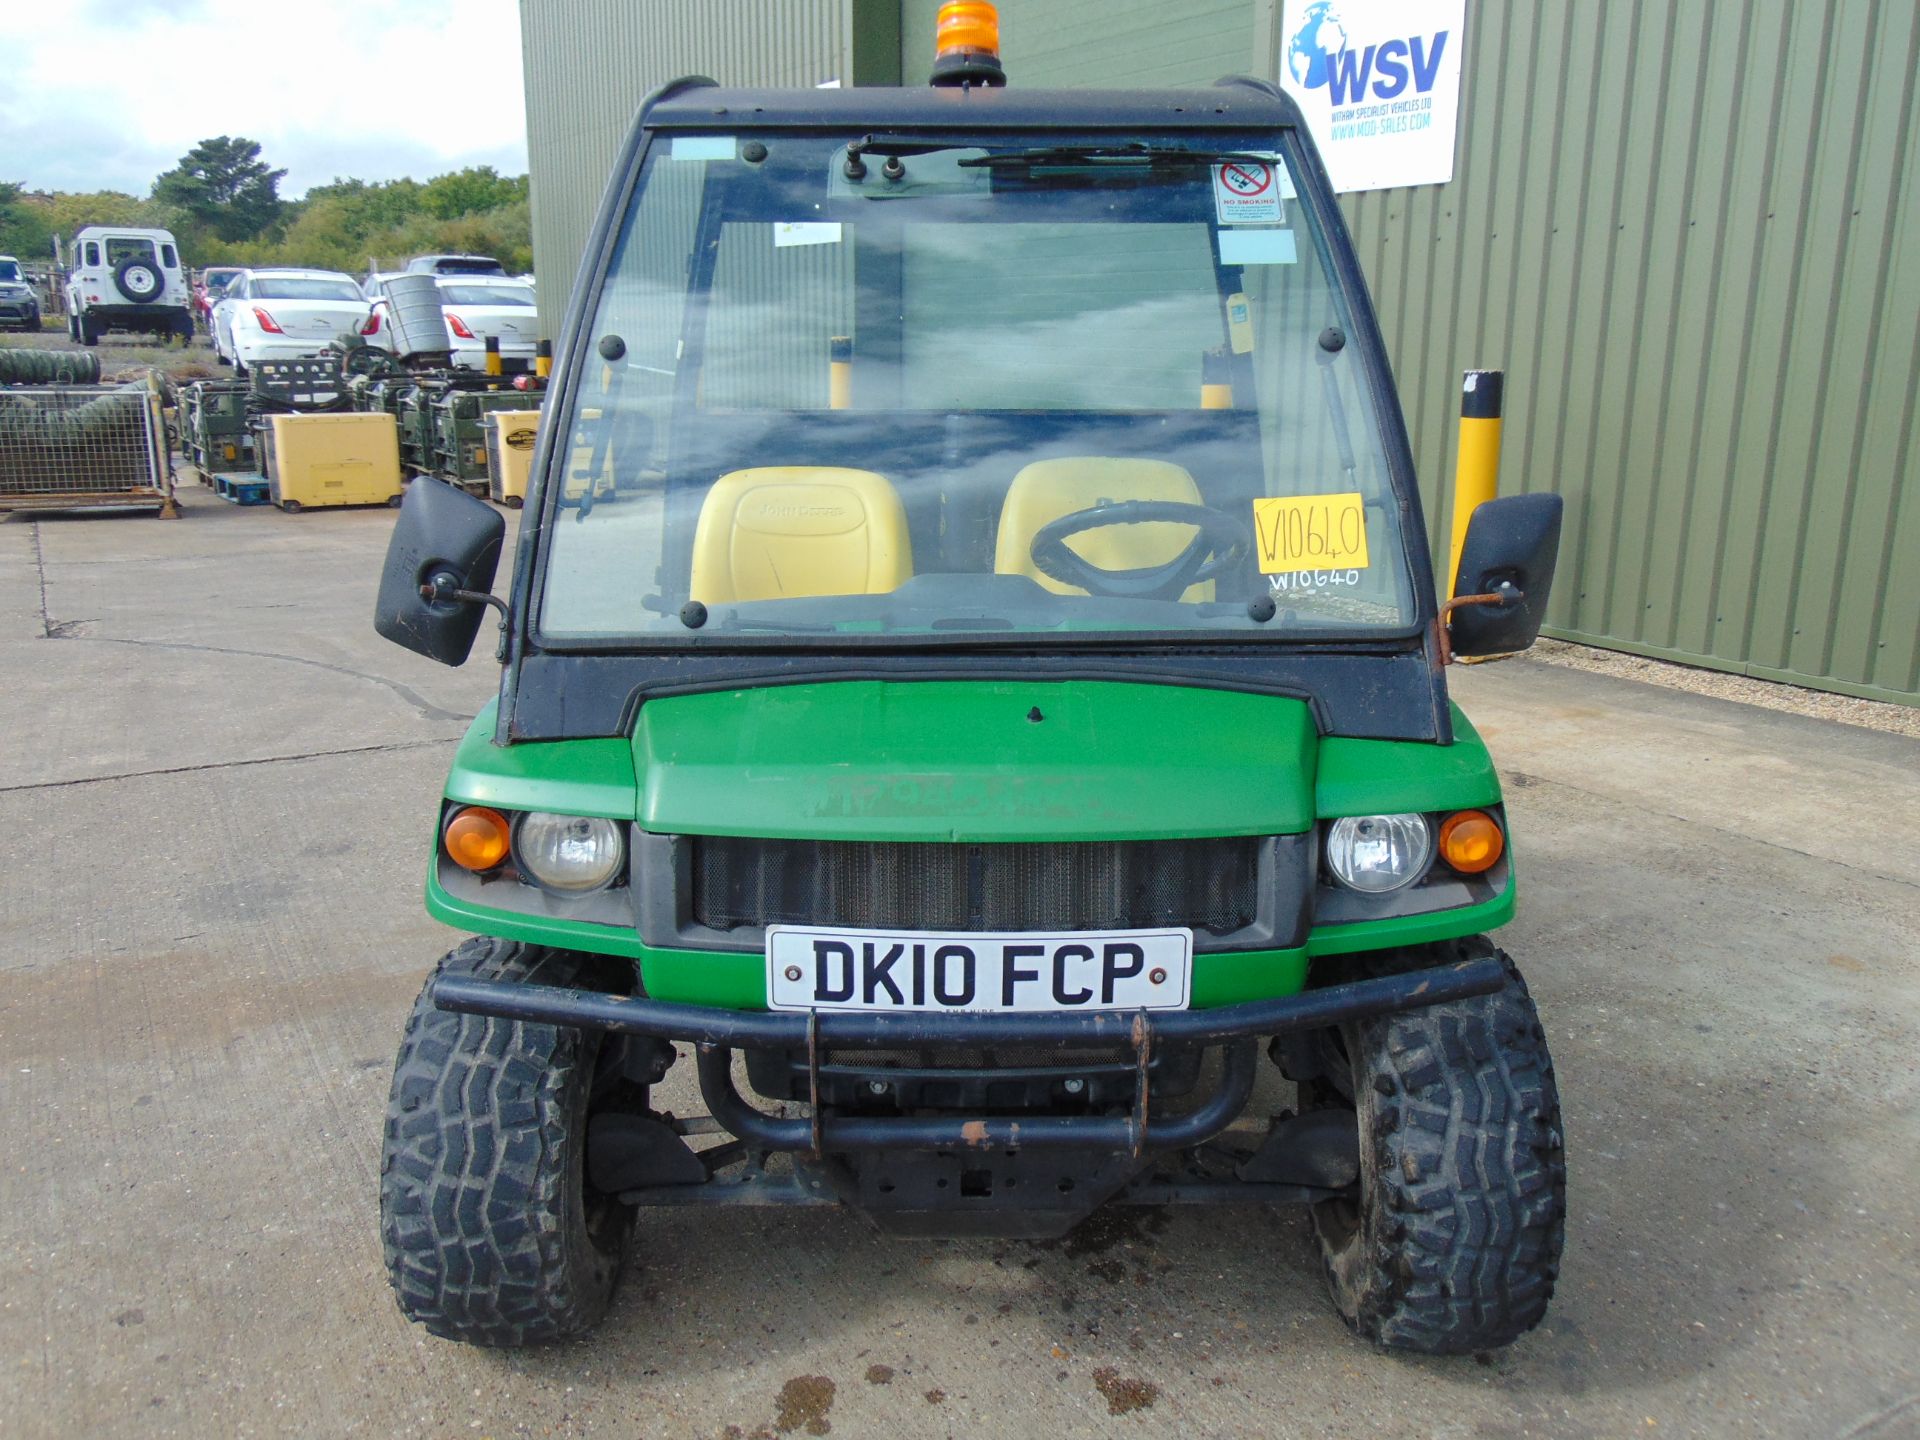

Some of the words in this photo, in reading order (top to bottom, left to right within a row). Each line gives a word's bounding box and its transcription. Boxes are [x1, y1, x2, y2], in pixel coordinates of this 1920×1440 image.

[1326, 30, 1449, 107] WSV
[1332, 110, 1355, 124] WITHAM
[1356, 103, 1389, 120] SPECIALIST
[1391, 98, 1420, 115] VEHICLES
[1420, 97, 1432, 111] LTD
[1331, 111, 1431, 141] WWWMOD-SALESCOM
[1237, 198, 1275, 206] SMOKING
[1256, 506, 1360, 562] W10640
[1269, 569, 1359, 590] W10640
[813, 939, 976, 1007] DK10
[1002, 942, 1145, 1007] FCP
